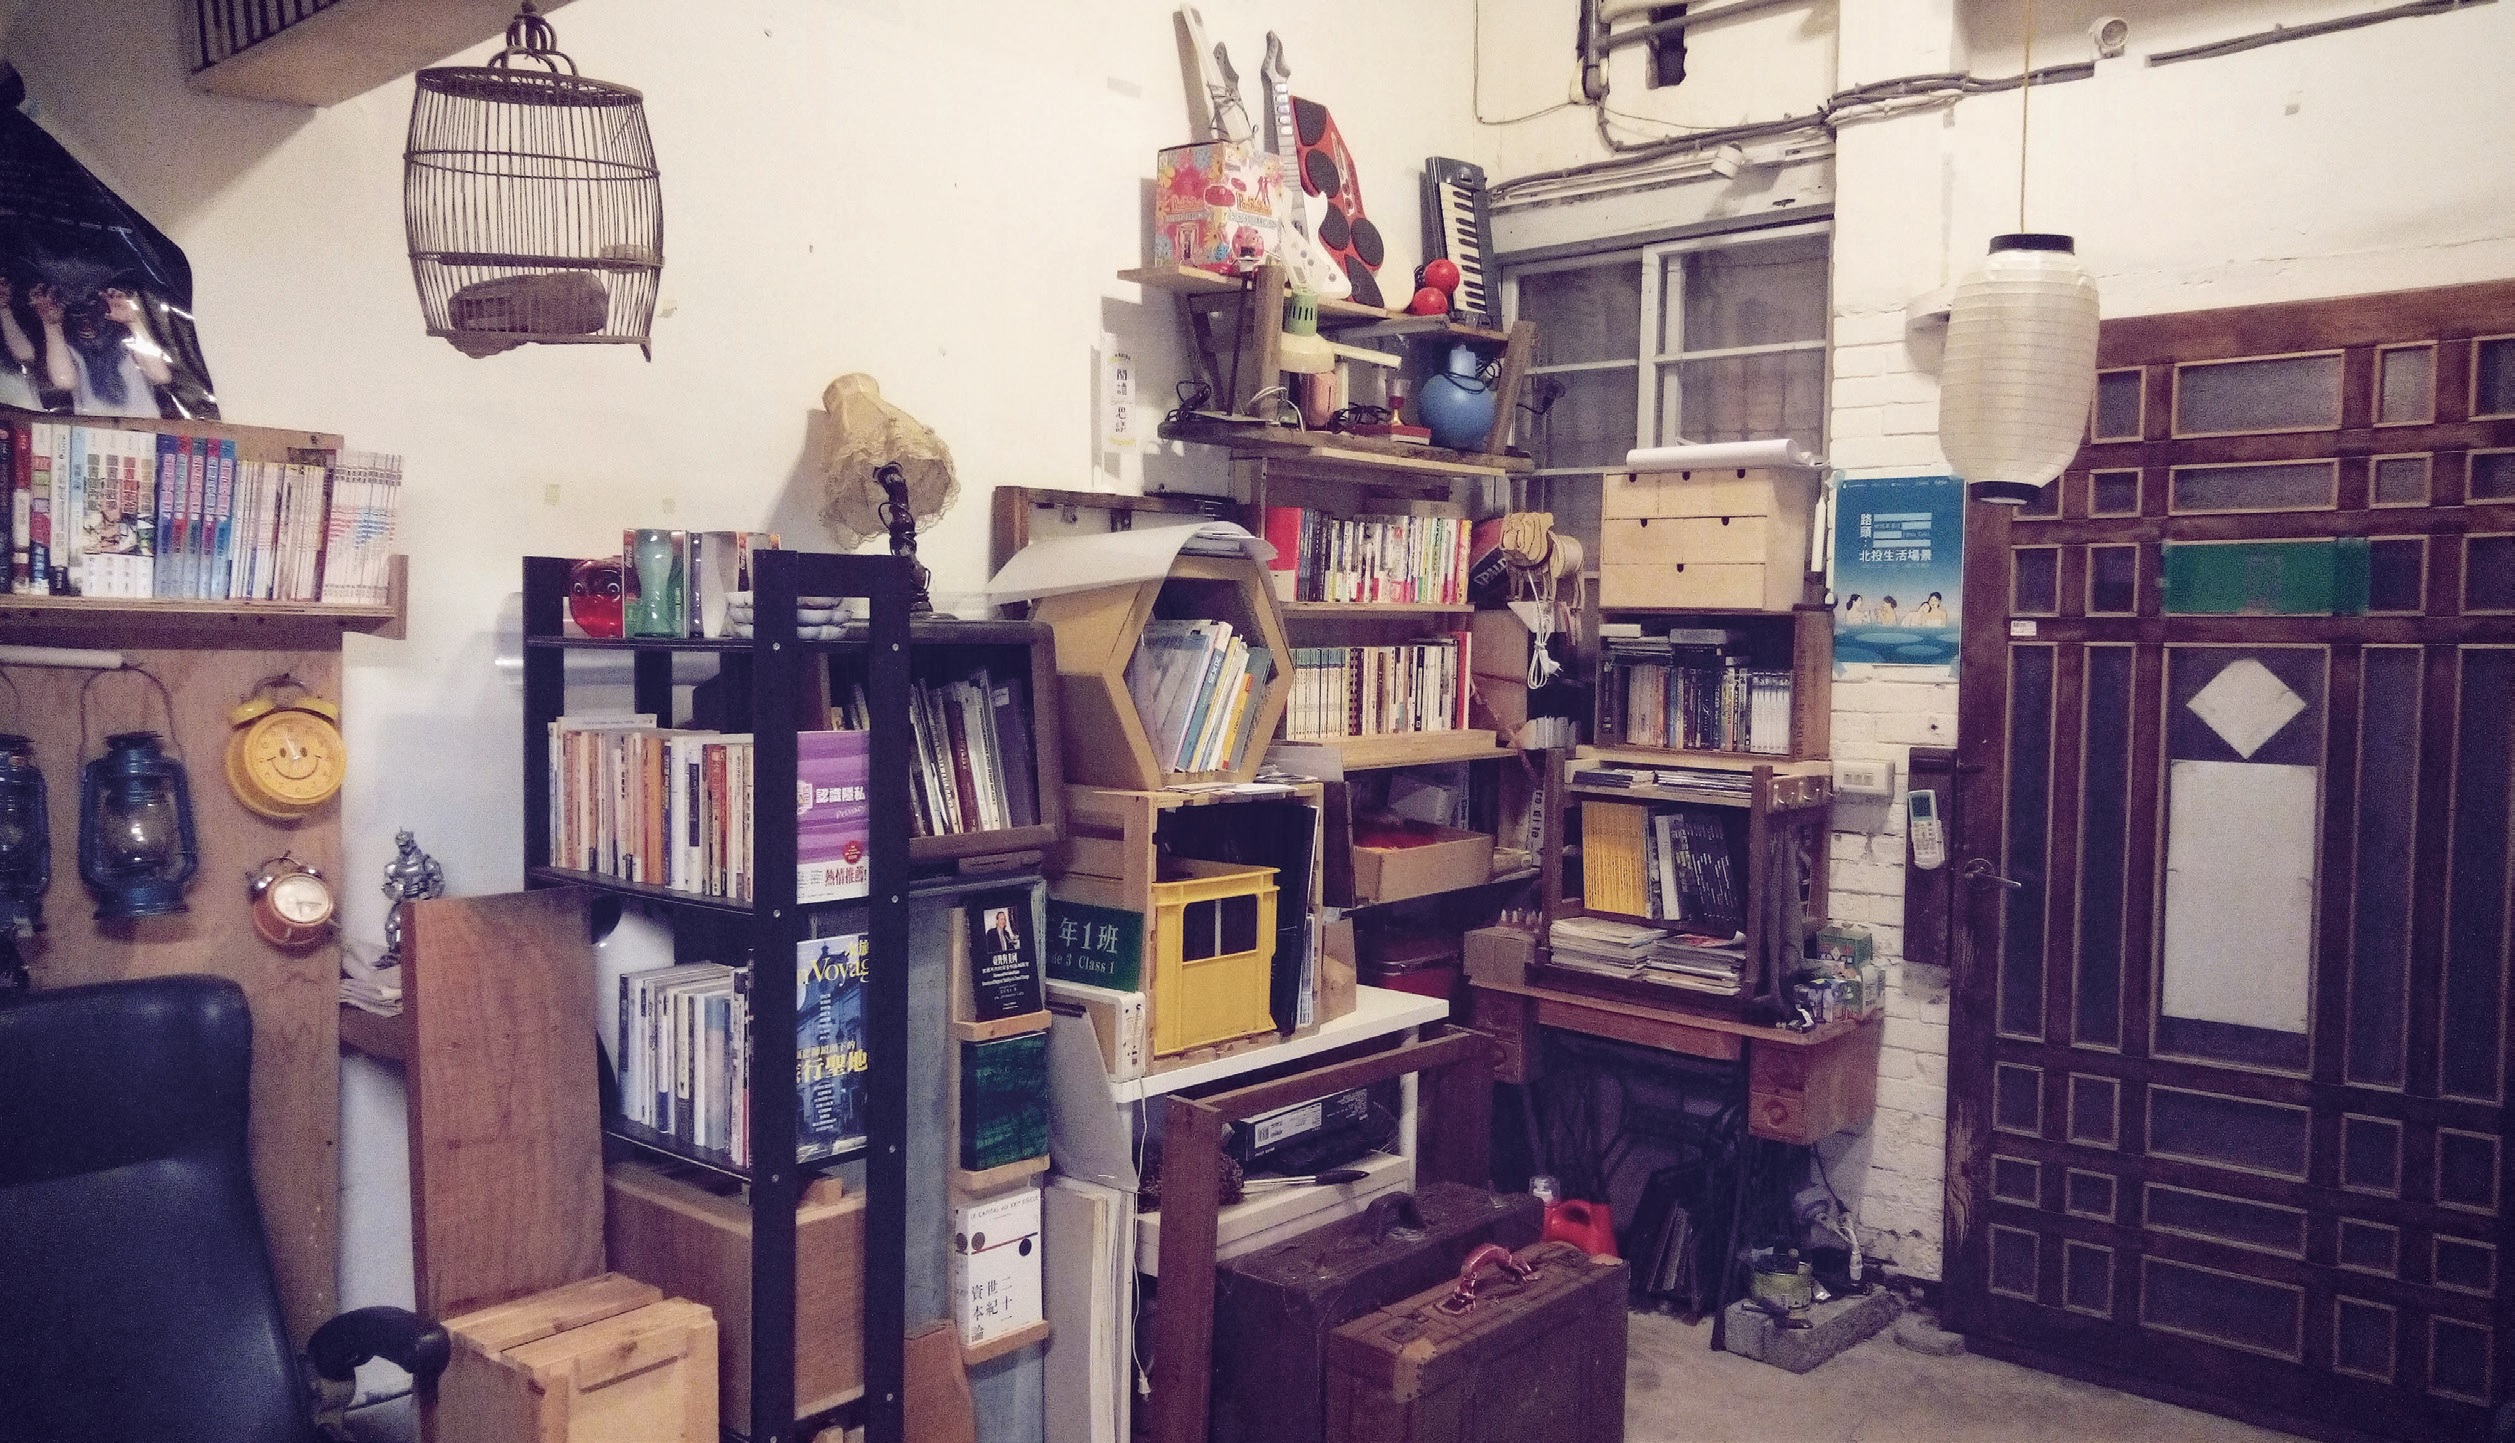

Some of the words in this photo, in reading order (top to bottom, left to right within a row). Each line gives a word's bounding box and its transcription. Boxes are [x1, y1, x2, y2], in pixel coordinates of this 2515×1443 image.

[811, 956, 869, 987] Voyag
[1065, 953, 1073, 967] 3
[1078, 954, 1106, 973] Class
[1109, 960, 1115, 975] 1
[796, 1048, 868, 1085] 行聖地
[971, 1284, 985, 1343] 資本論
[985, 1279, 999, 1316] 世紀
